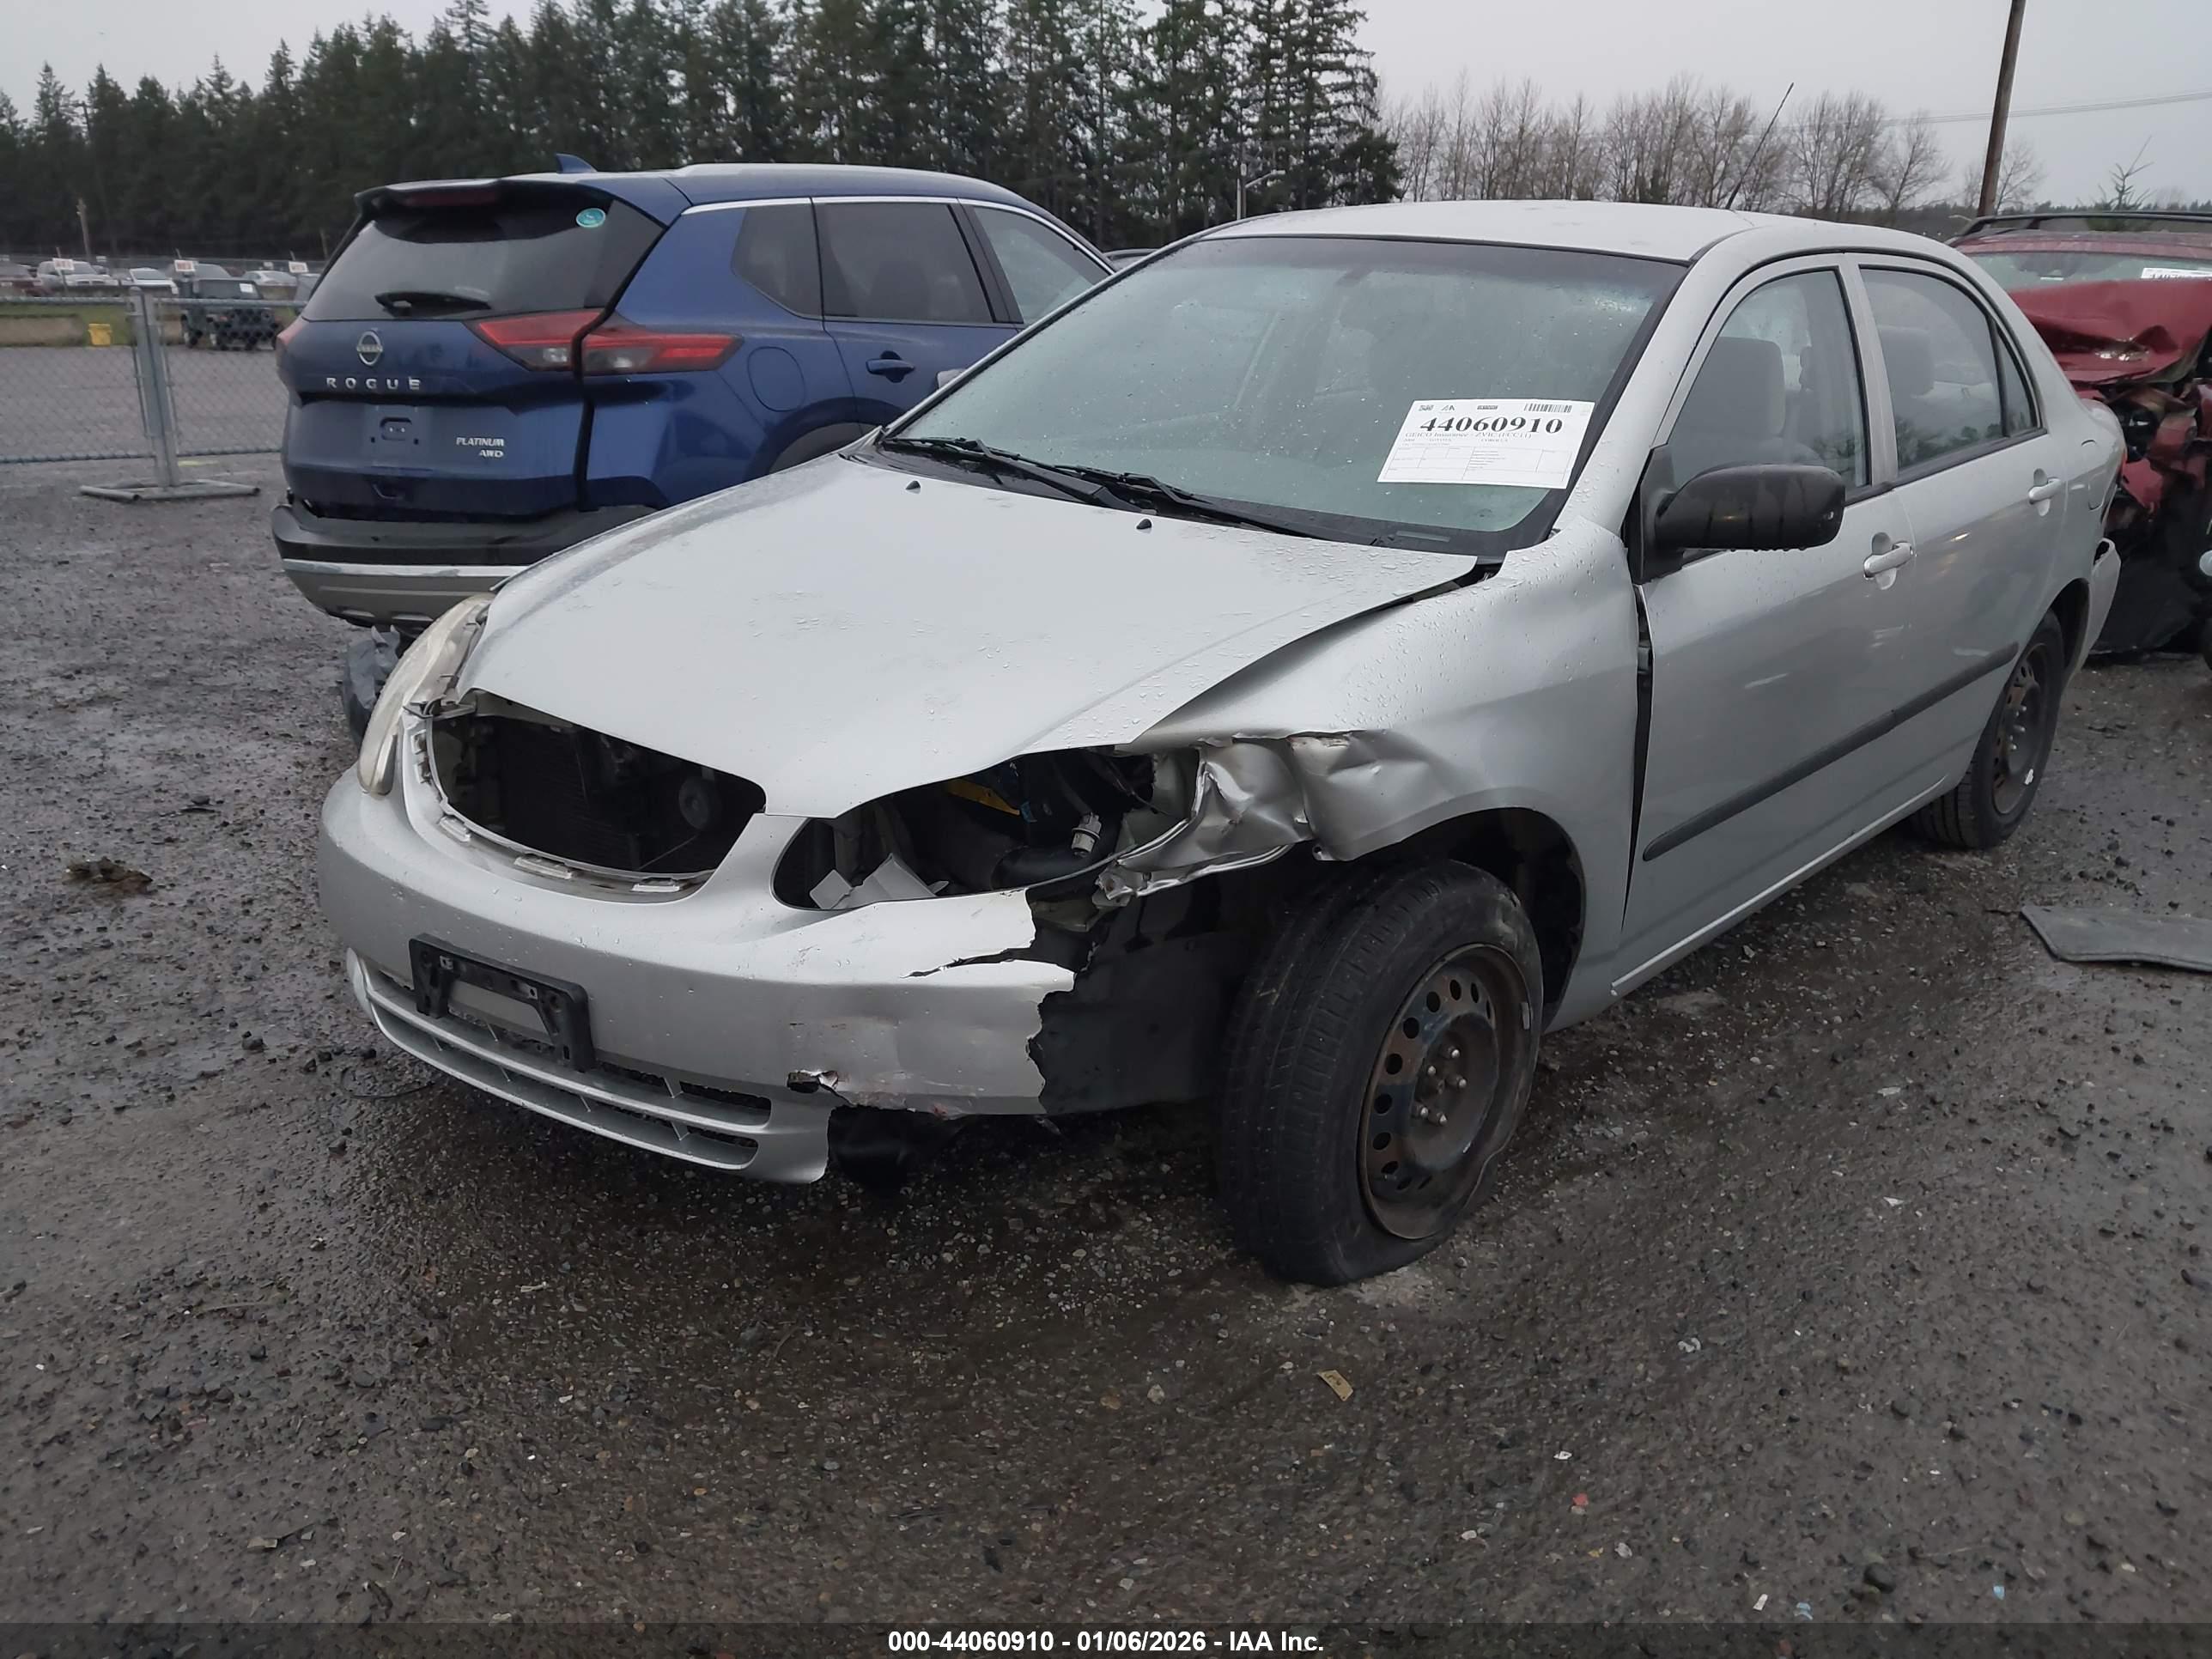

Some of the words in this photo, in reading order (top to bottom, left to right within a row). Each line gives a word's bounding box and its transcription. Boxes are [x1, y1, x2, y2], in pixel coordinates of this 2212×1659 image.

[325, 376, 421, 390] ROGUE
[1419, 416, 1563, 434] 44060910
[456, 437, 505, 447] PLATINUM
[478, 449, 504, 458] AWD
